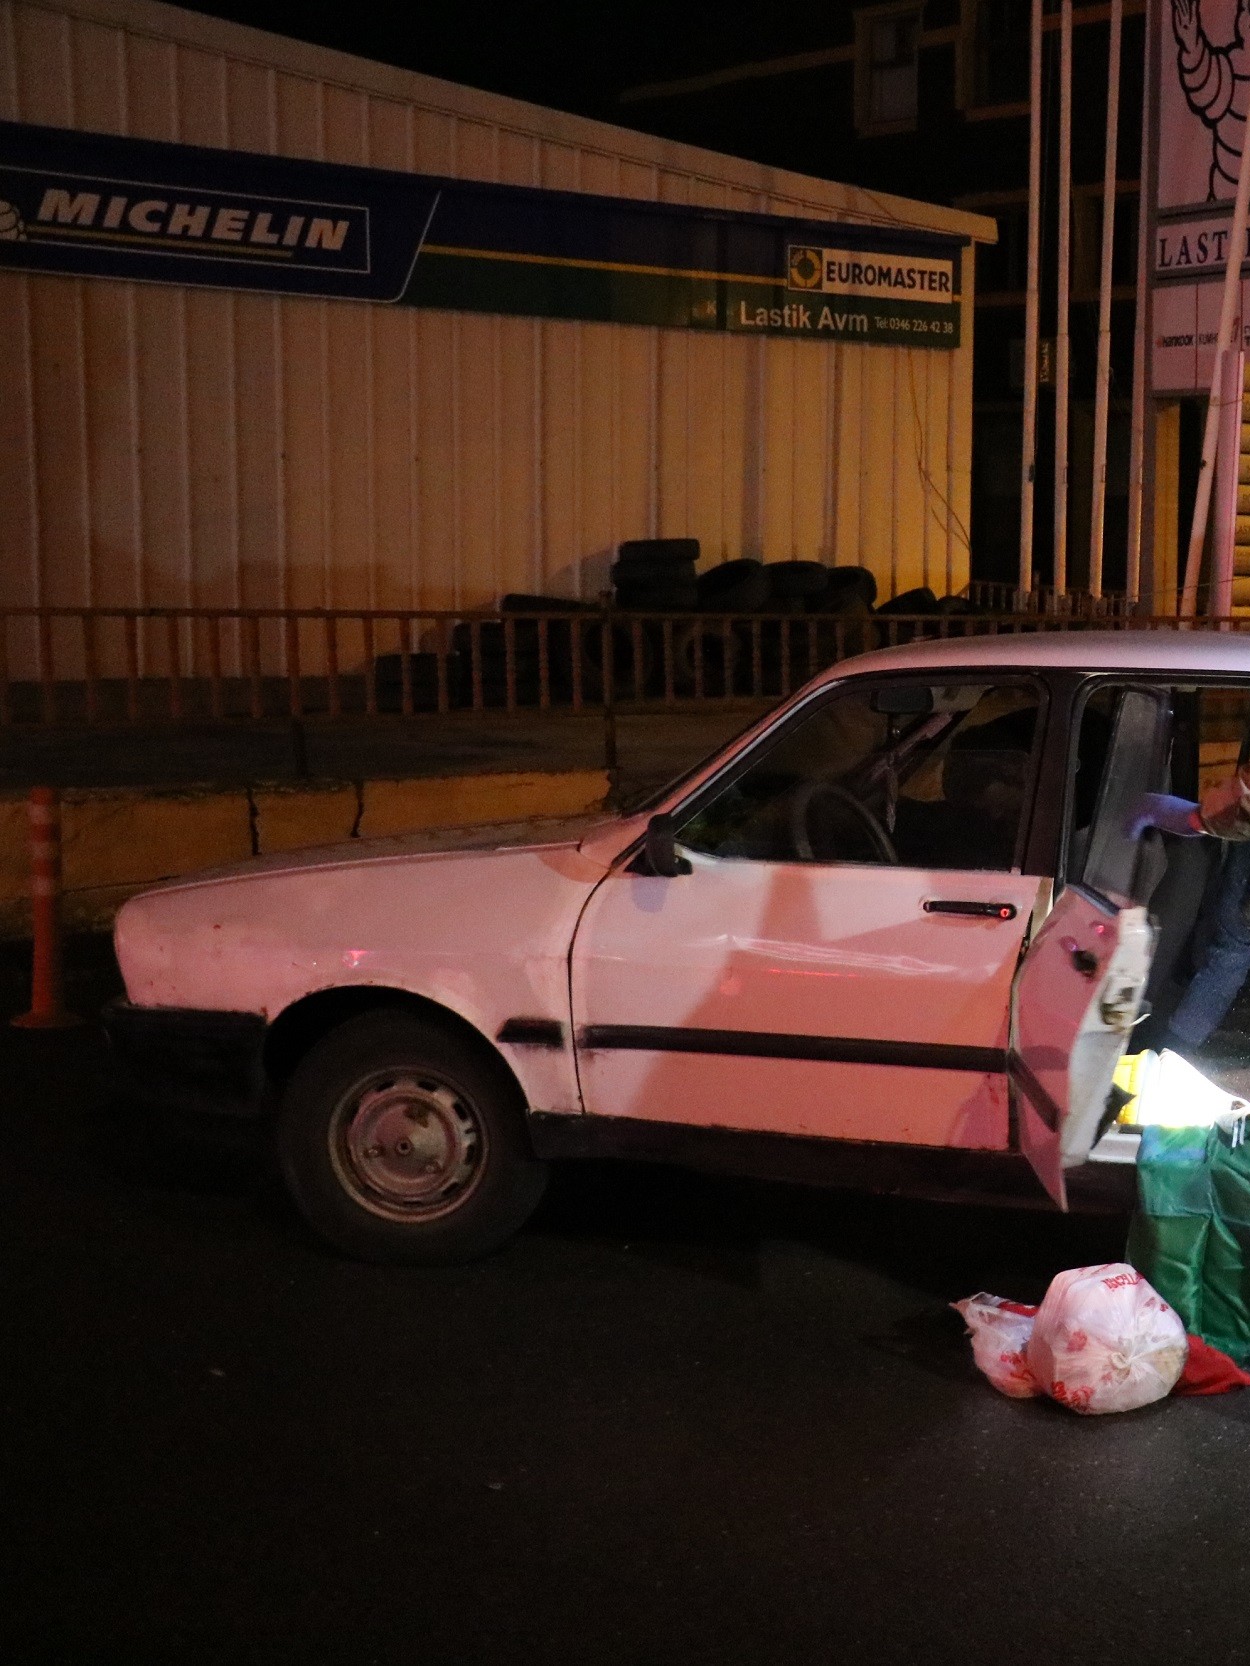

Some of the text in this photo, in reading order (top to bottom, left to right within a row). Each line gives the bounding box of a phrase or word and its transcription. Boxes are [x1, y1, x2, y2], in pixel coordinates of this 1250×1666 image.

[36, 188, 350, 252] MICHELIN
[825, 259, 951, 293] EUROMASTER
[740, 301, 812, 329] Lastik
[817, 305, 869, 333] Avm
